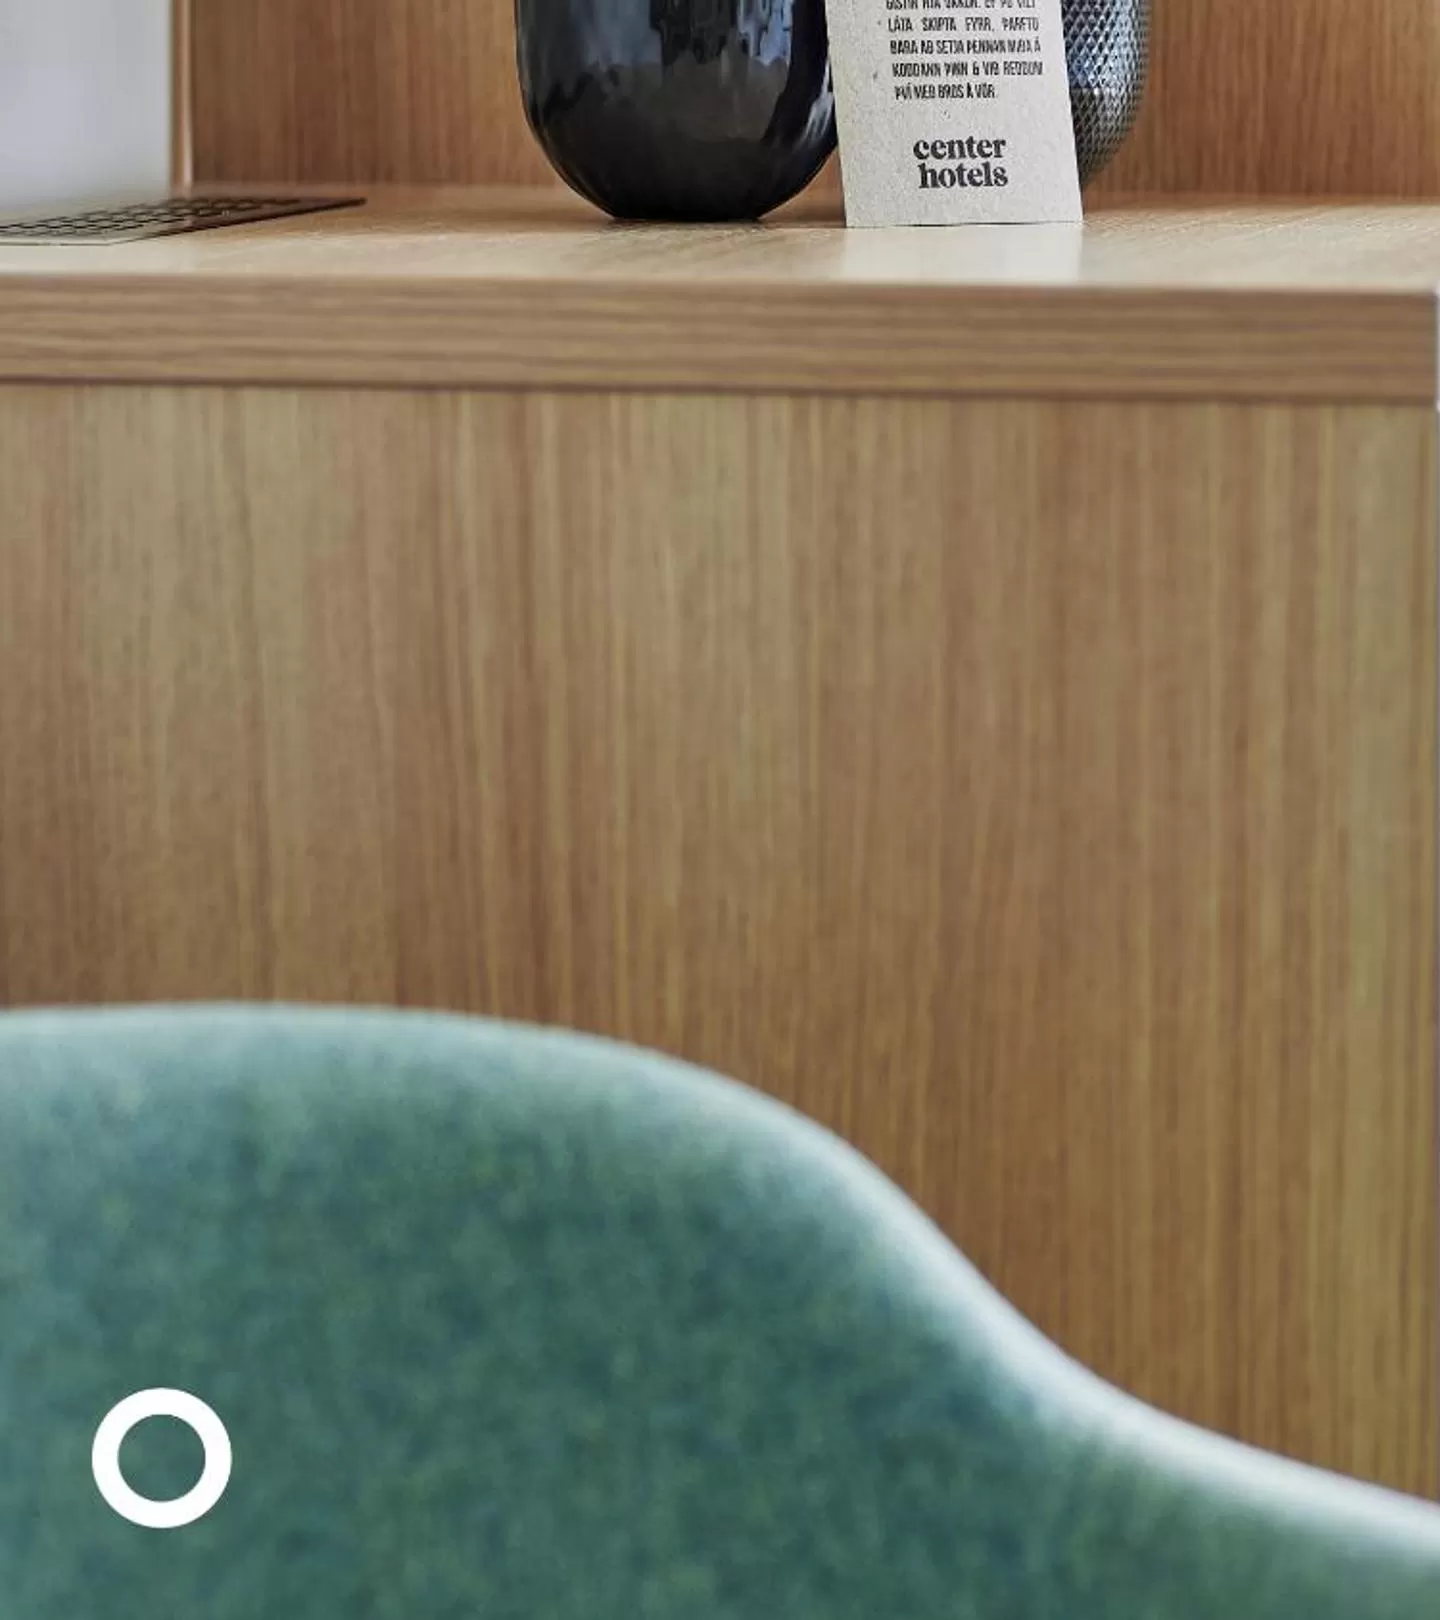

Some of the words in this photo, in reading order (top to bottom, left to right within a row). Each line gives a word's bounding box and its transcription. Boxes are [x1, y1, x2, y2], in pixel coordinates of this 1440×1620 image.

[888, 15, 914, 32] LÁTA
[921, 16, 957, 32] SKIPTA
[890, 39, 918, 54] BARA
[936, 39, 965, 54] SETJA
[1034, 36, 1041, 53] Á
[938, 84, 965, 99] BROS
[913, 135, 1007, 160] center
[918, 161, 1008, 189] hotels
